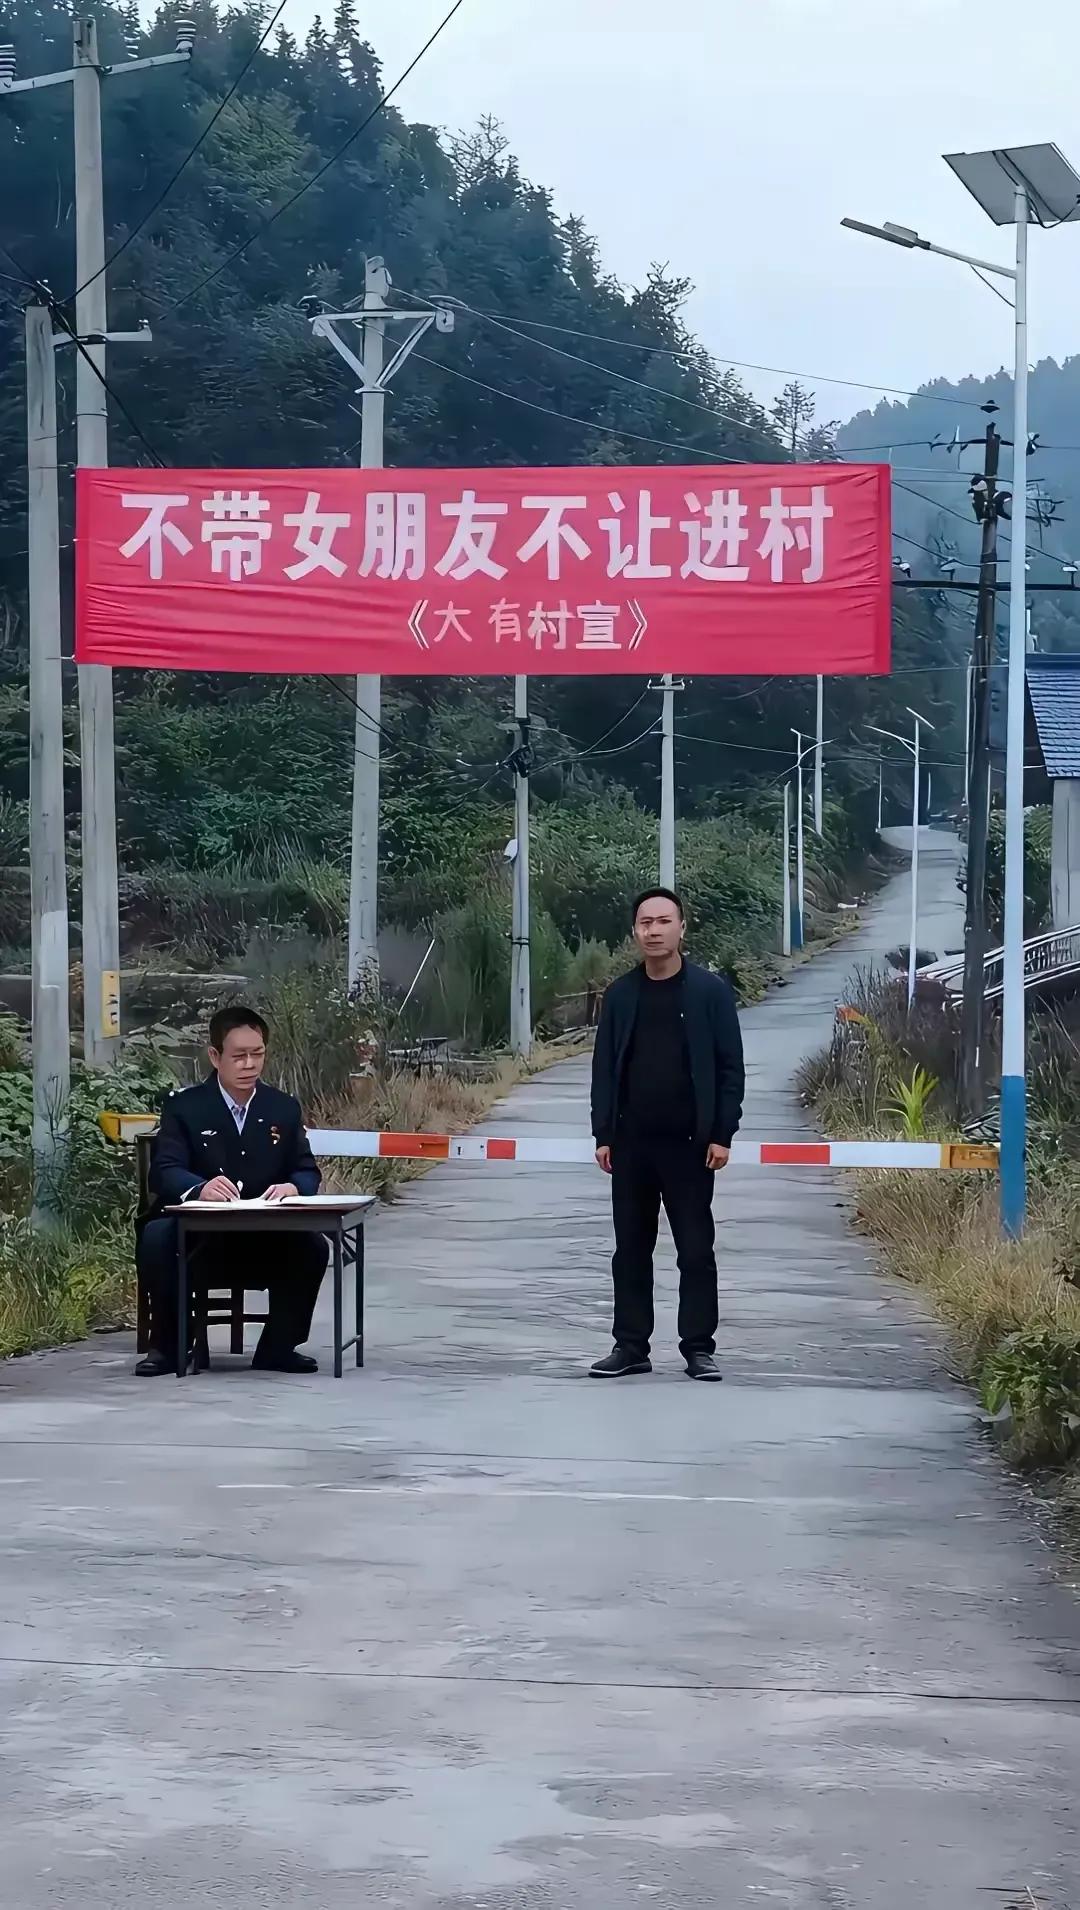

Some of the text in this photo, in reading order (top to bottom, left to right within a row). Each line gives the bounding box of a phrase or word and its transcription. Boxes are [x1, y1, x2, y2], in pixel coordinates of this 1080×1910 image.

[119, 486, 834, 584] 不带女朋友不让进村
